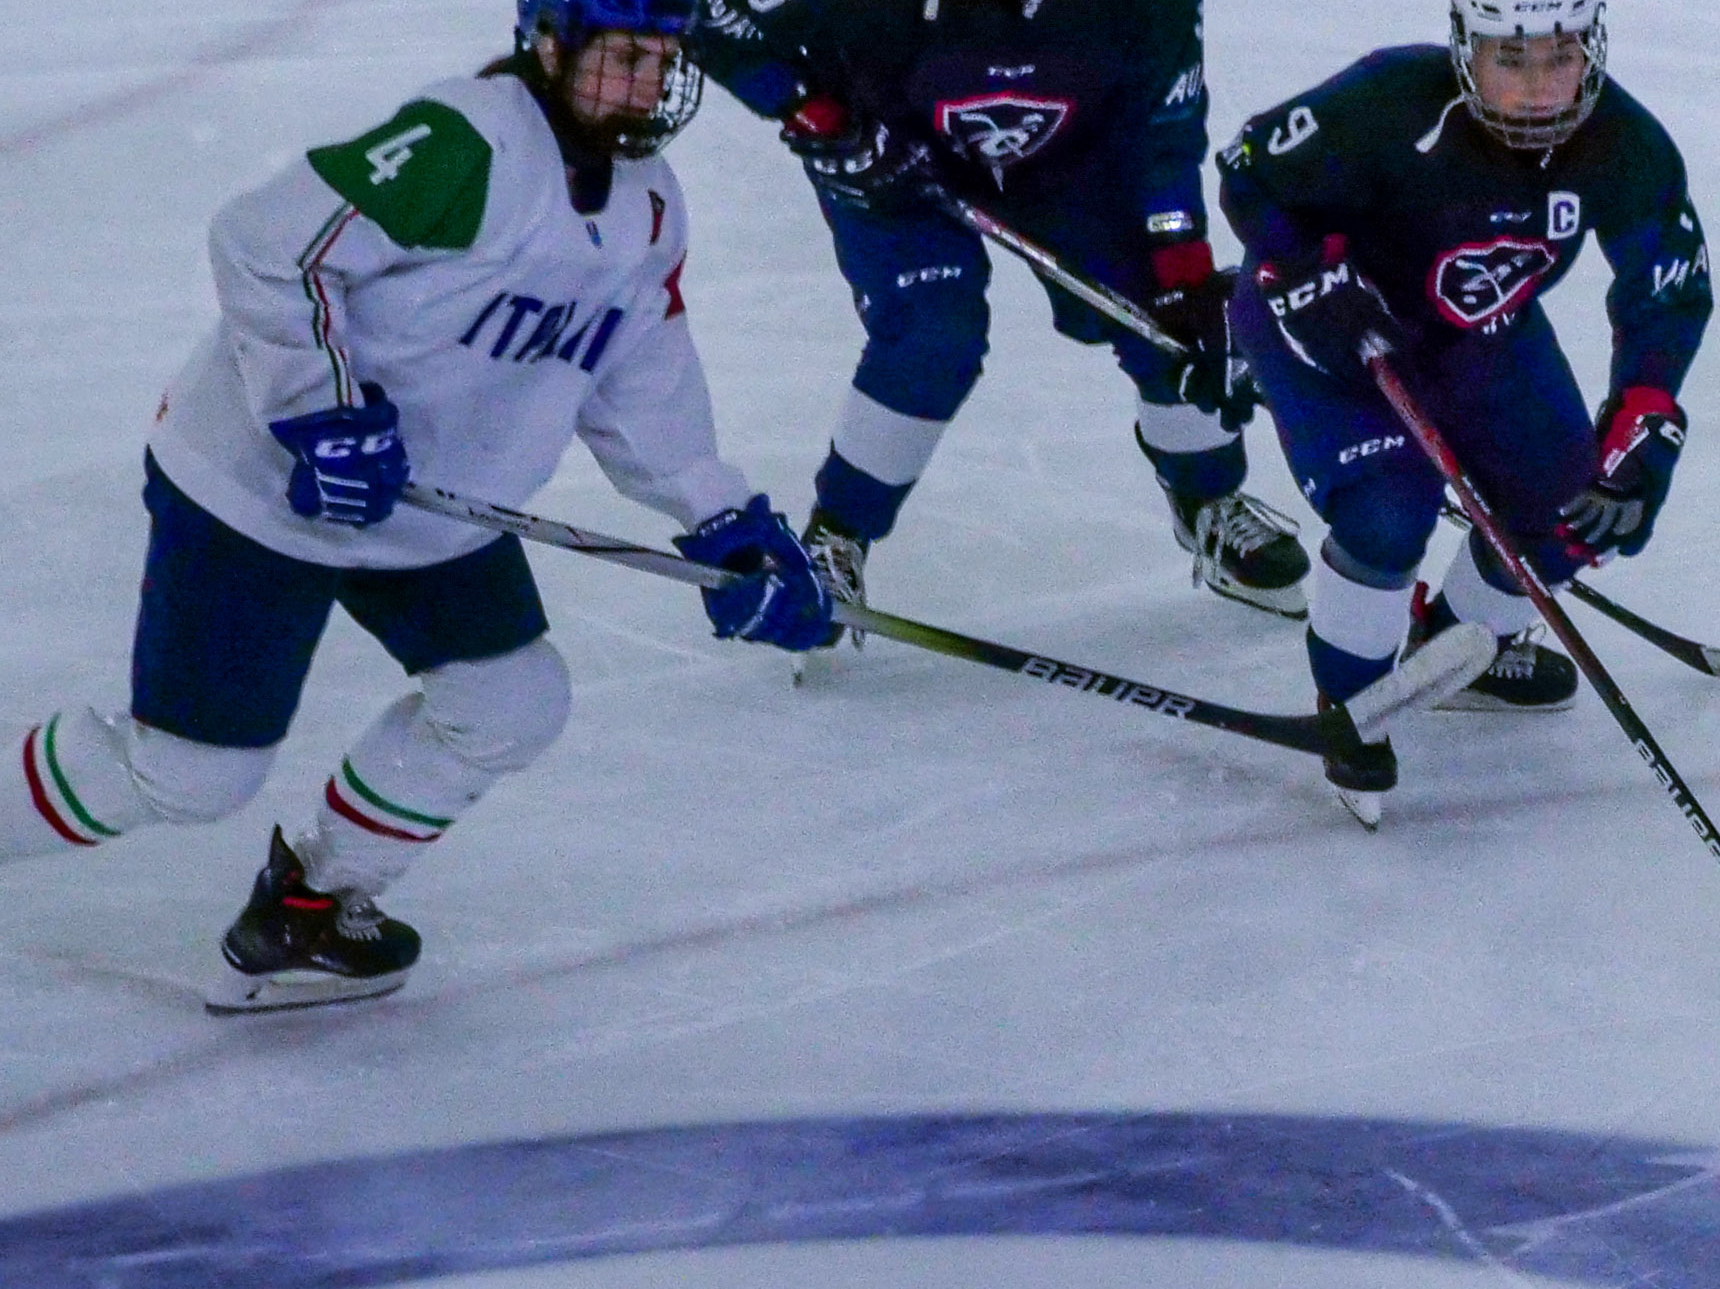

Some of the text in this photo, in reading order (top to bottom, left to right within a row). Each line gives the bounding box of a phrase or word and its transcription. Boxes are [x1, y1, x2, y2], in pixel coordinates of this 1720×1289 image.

[364, 122, 432, 186] 4
[1267, 106, 1319, 155] 9
[1552, 200, 1576, 233] C
[1267, 262, 1350, 317] CCM
[1338, 432, 1406, 465] CCM
